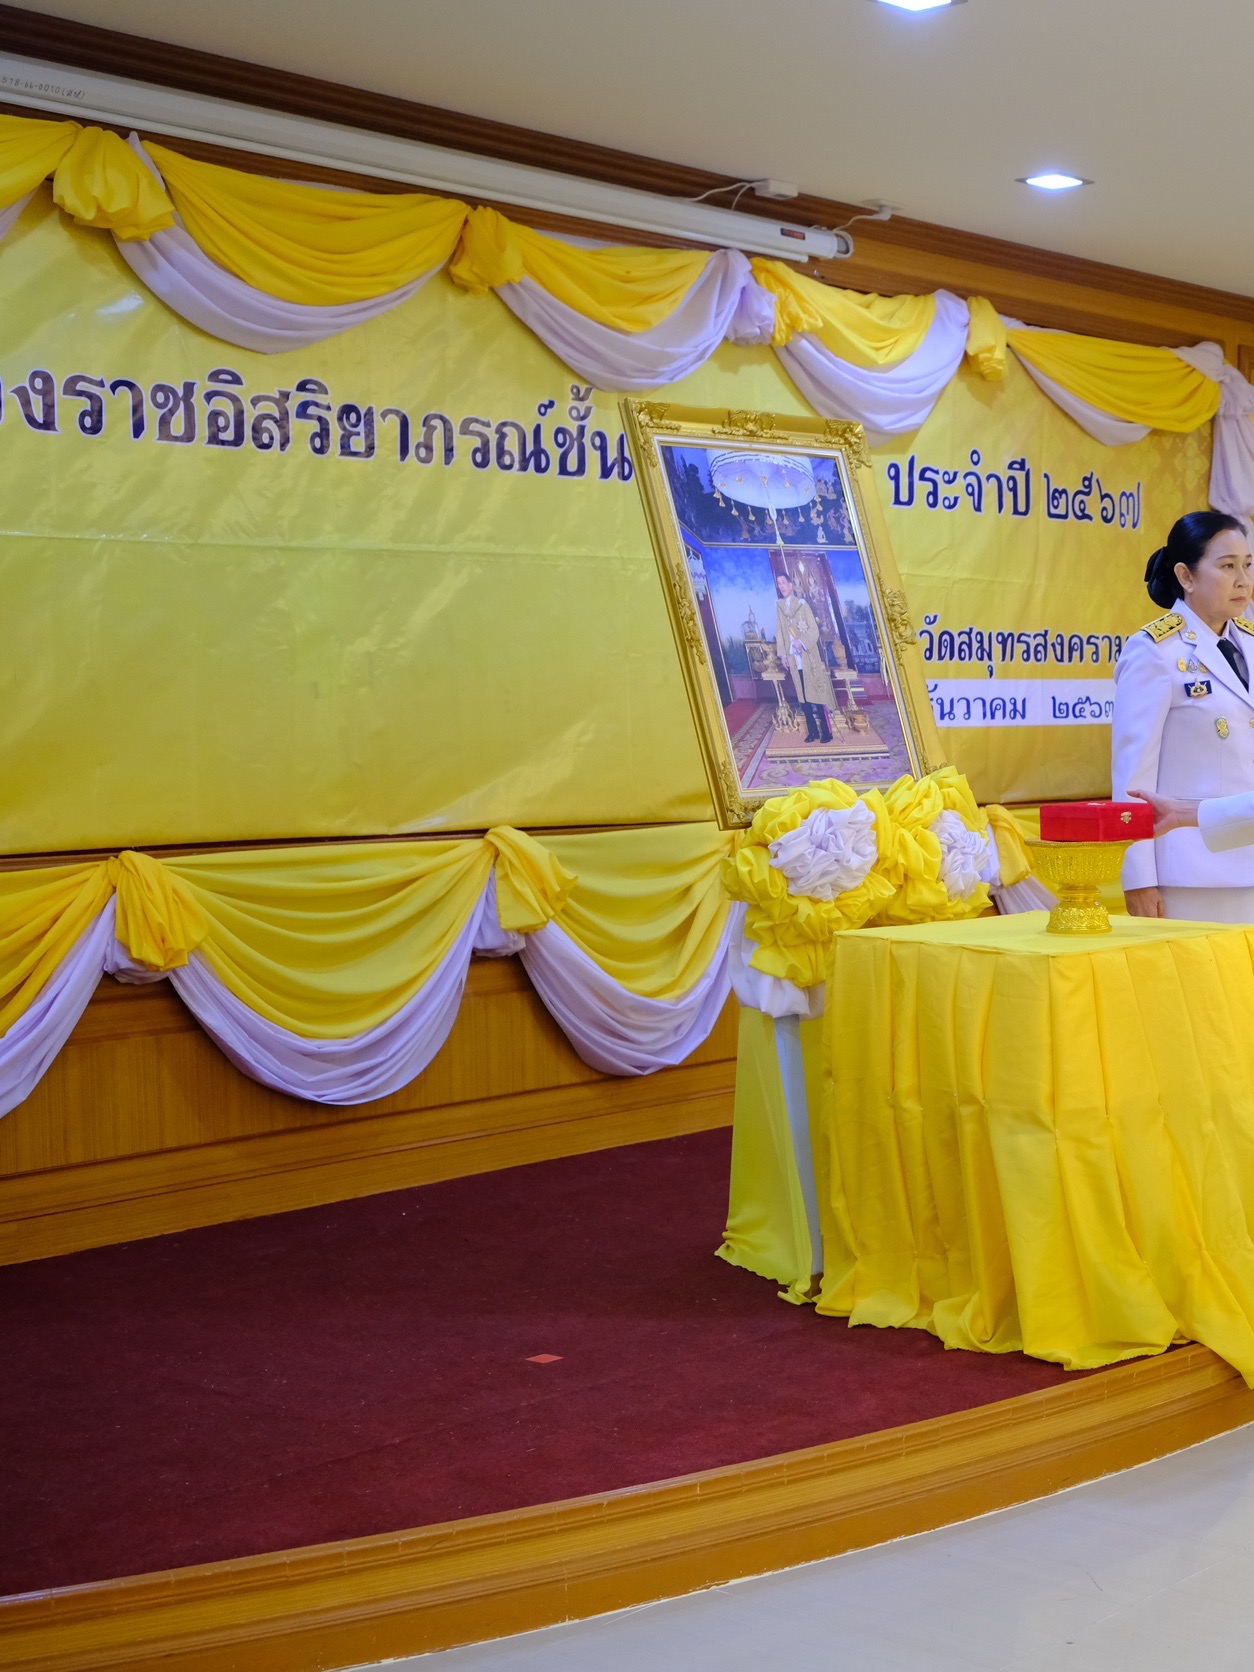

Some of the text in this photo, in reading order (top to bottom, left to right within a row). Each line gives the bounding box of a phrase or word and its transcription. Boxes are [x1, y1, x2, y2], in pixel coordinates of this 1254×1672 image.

[0, 367, 1141, 530] งราชอิสริยาภรณ์ชั้น ประจำปี ๒๕๖๗
[917, 614, 1129, 678] วัดสมุทรสงคราม
[926, 683, 1027, 721] ันวาคม
